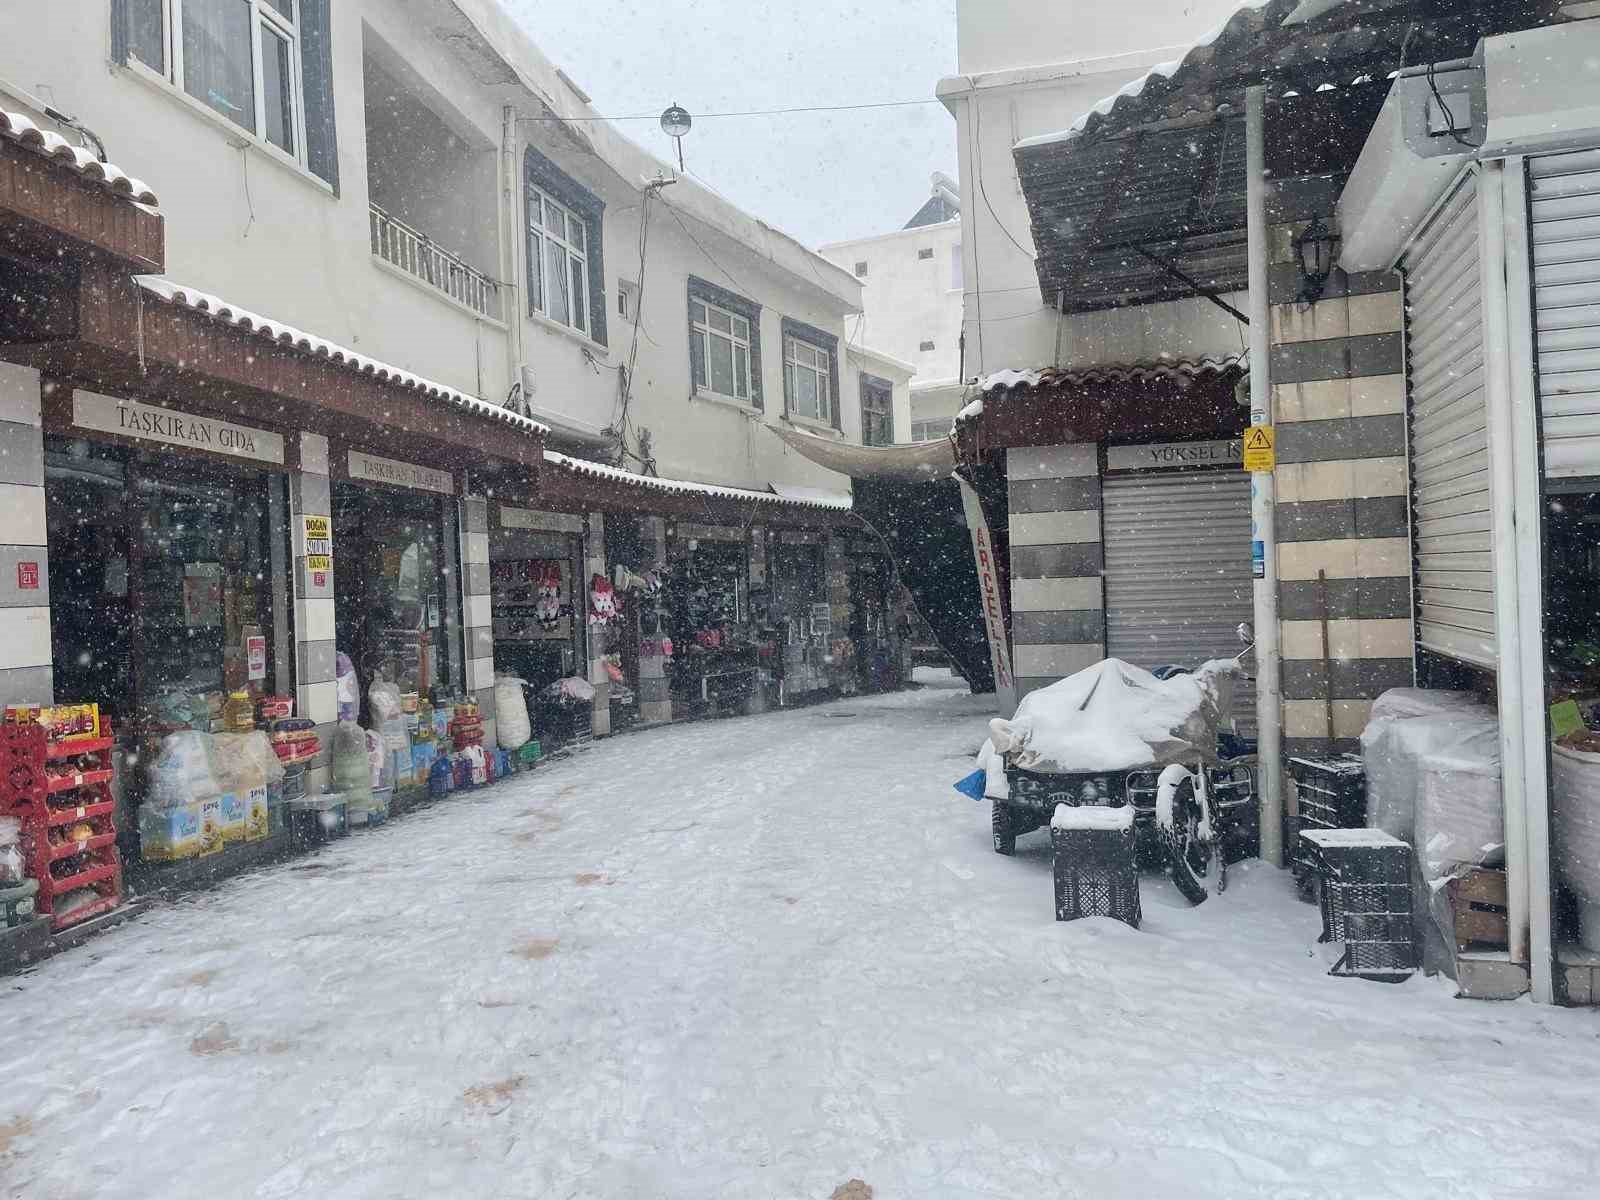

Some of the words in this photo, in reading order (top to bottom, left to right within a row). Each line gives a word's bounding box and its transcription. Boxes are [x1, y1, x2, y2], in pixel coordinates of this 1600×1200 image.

[116, 405, 211, 443] TAŞKIRAN
[219, 428, 256, 453] GIDA
[1151, 445, 1217, 463] YÜKSEL
